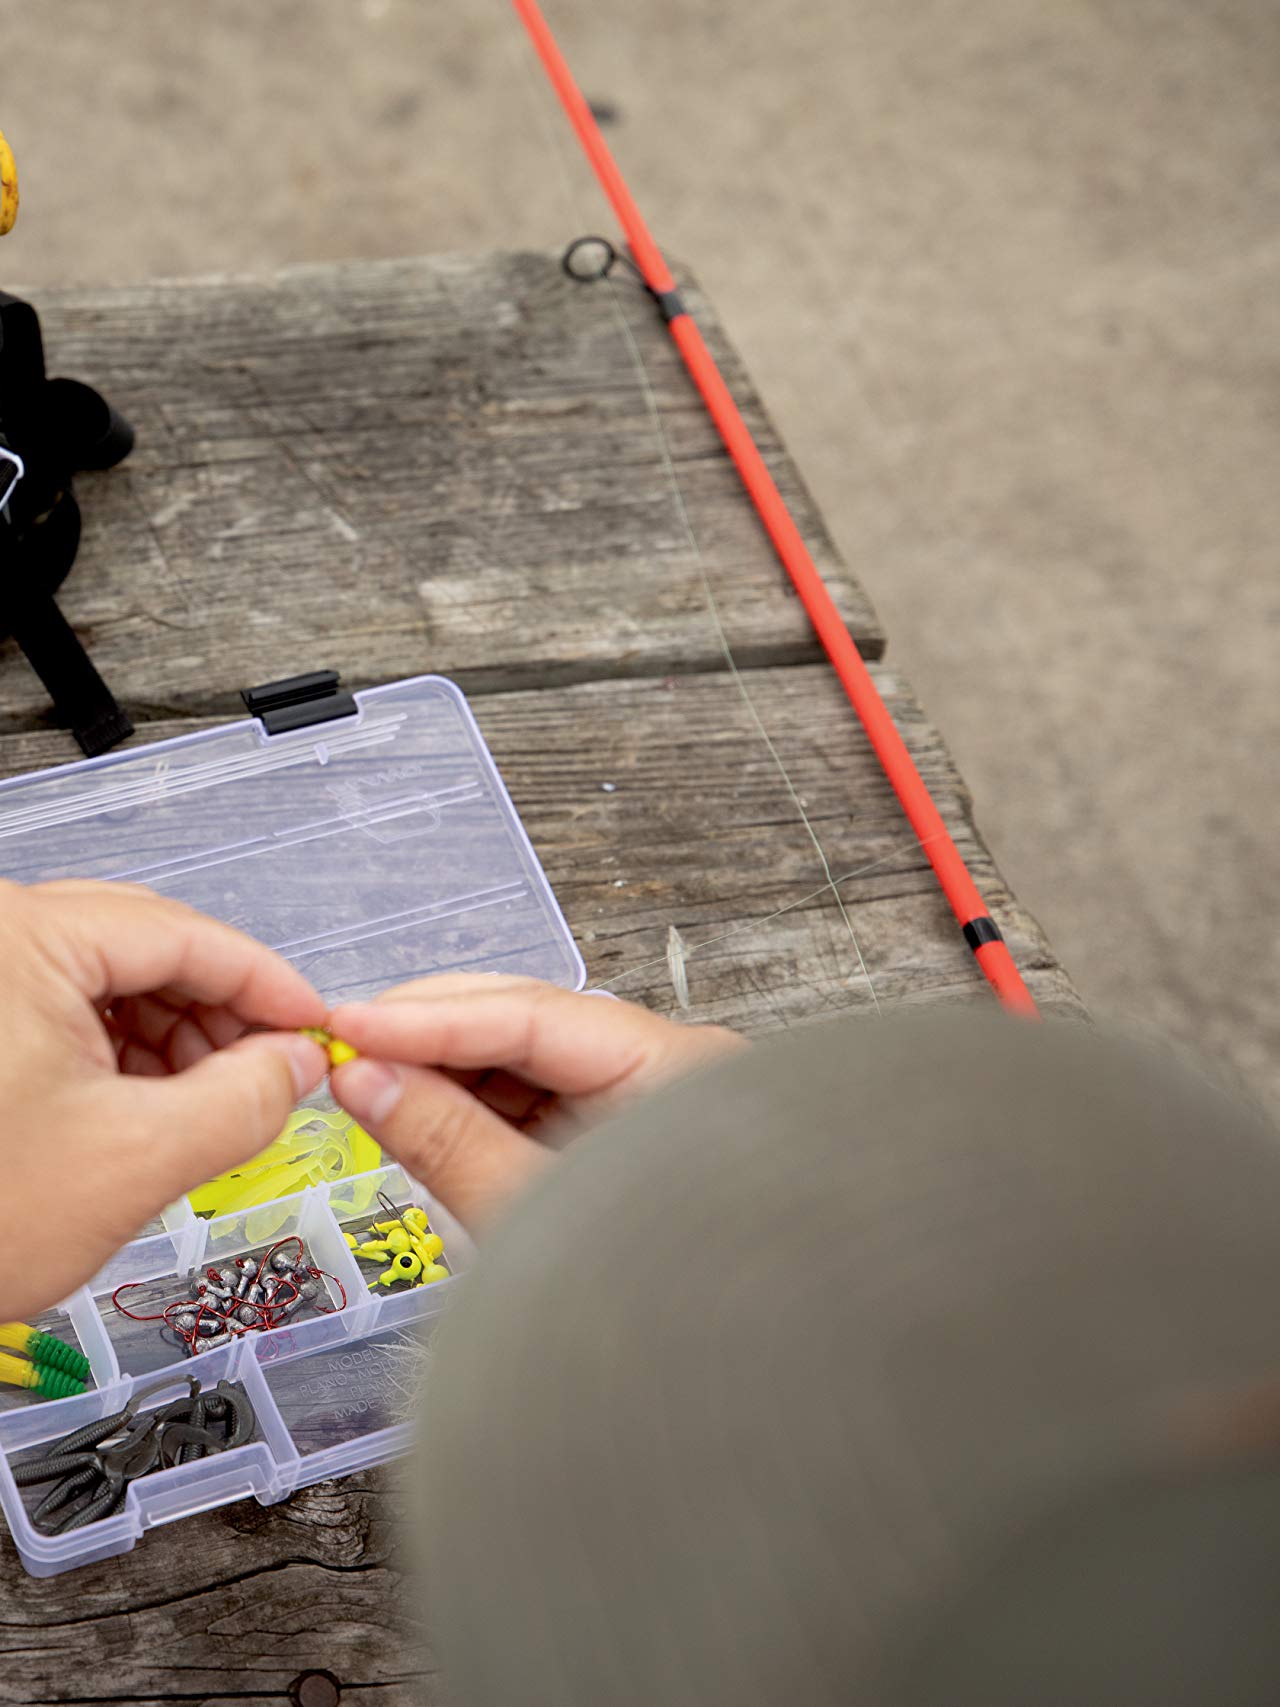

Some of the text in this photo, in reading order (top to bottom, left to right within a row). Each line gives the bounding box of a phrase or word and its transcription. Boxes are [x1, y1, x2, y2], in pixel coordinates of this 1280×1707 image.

[327, 1347, 379, 1372] MODEL
[300, 1373, 348, 1397] PLANO
[334, 1400, 380, 1420] MADE
